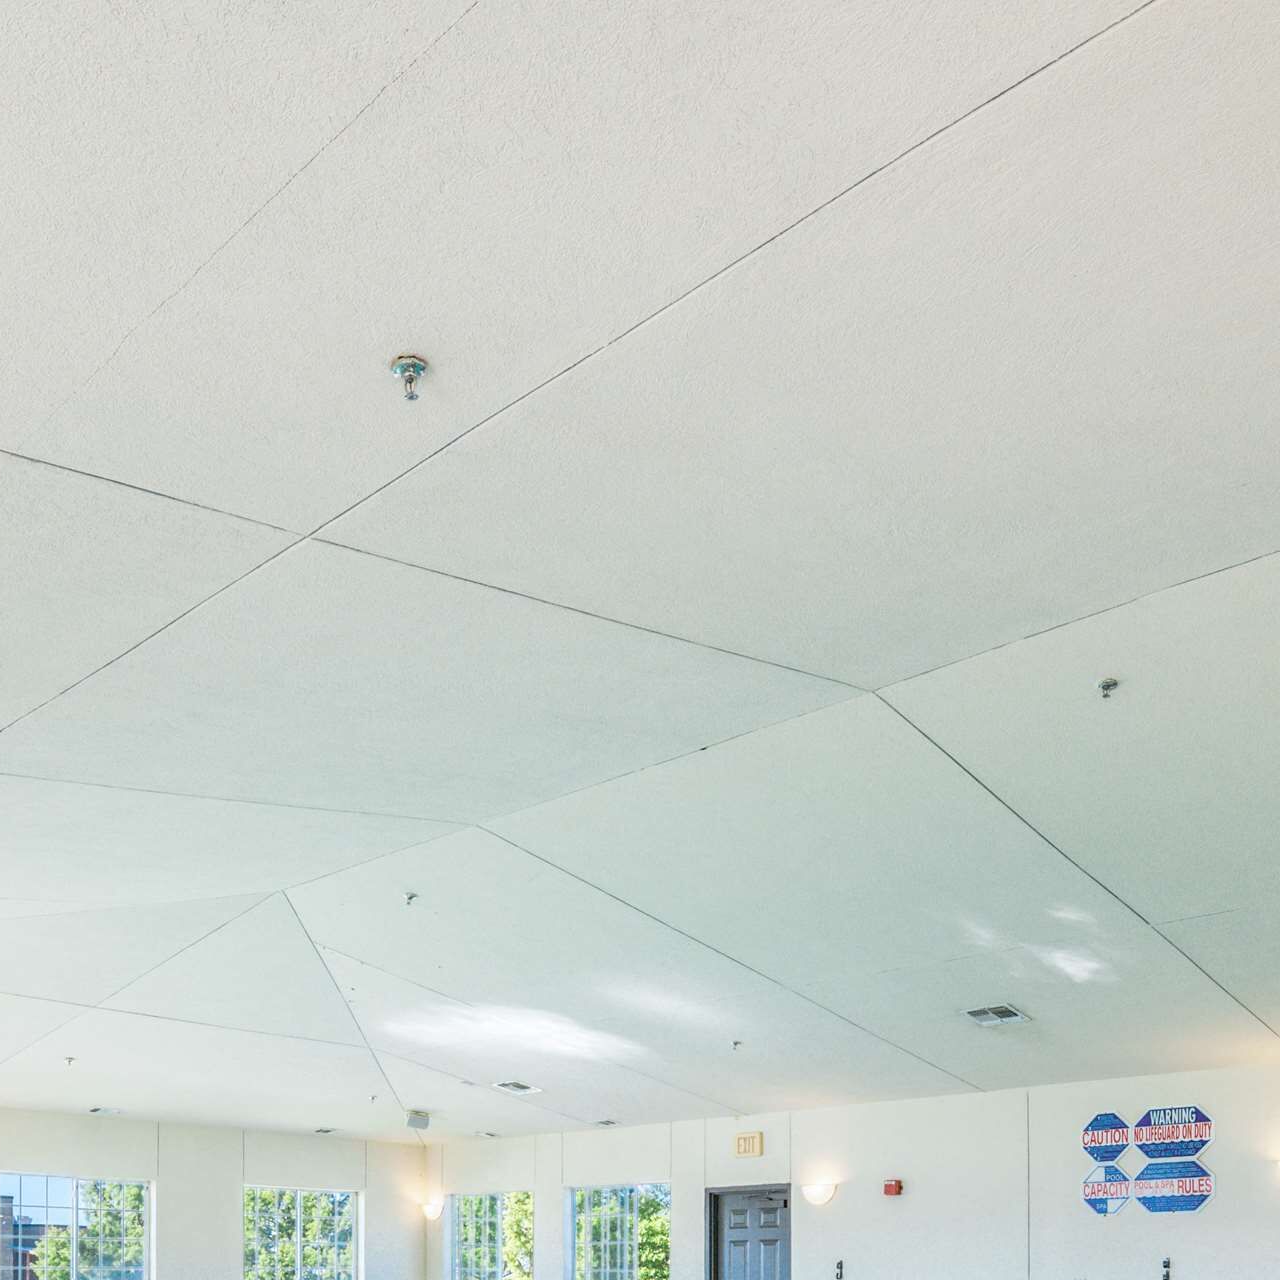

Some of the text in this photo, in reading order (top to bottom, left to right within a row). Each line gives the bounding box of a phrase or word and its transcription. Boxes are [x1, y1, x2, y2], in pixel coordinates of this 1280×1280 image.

[1150, 1107, 1196, 1125] WARNING
[1082, 1129, 1129, 1146] CAUTION
[1134, 1122, 1212, 1142] NO LIFEGUARD ON DUTY
[737, 1136, 756, 1154] EXIT
[1083, 1183, 1130, 1197] CAPACITY
[1177, 1178, 1212, 1194] RULES
